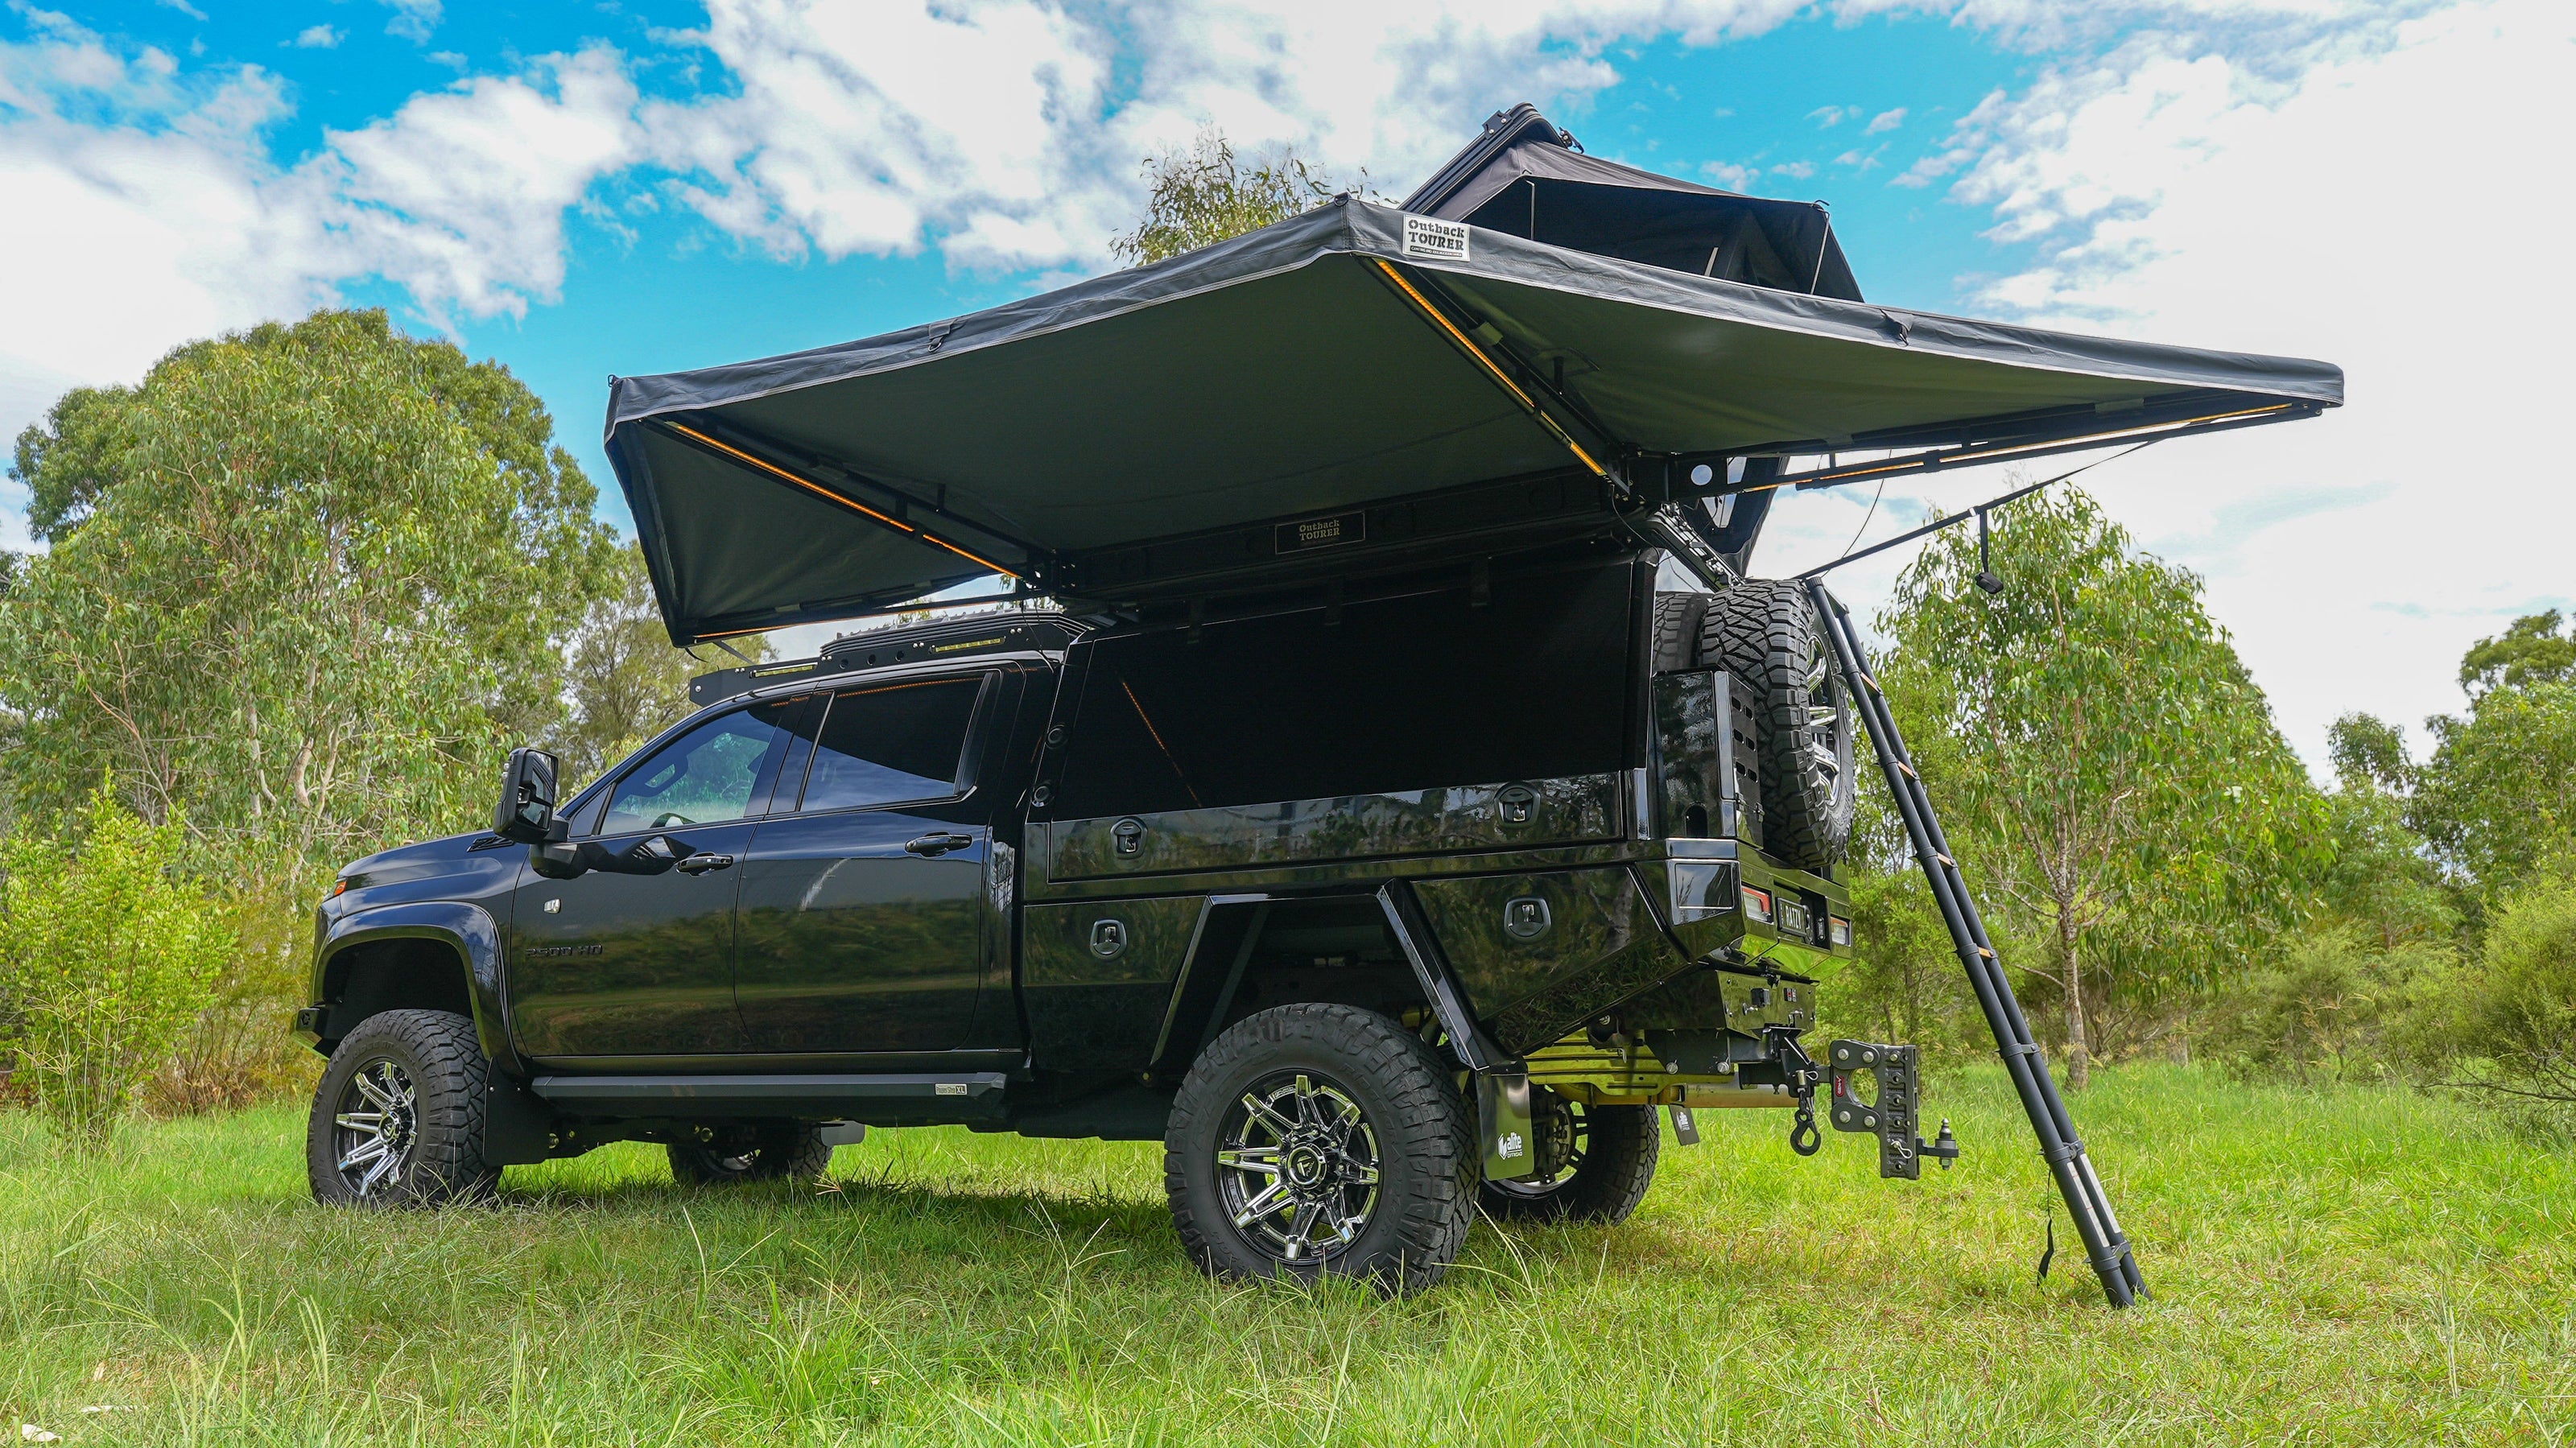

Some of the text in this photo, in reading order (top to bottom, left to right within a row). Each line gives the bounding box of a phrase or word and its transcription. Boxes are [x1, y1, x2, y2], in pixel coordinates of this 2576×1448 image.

[1408, 219, 1464, 238] Outback
[1408, 231, 1463, 250] TOURER
[1299, 519, 1340, 533] Outback
[1299, 528, 1340, 541] TOURER
[526, 944, 603, 957] 2500 HD
[956, 1086, 966, 1094] XL
